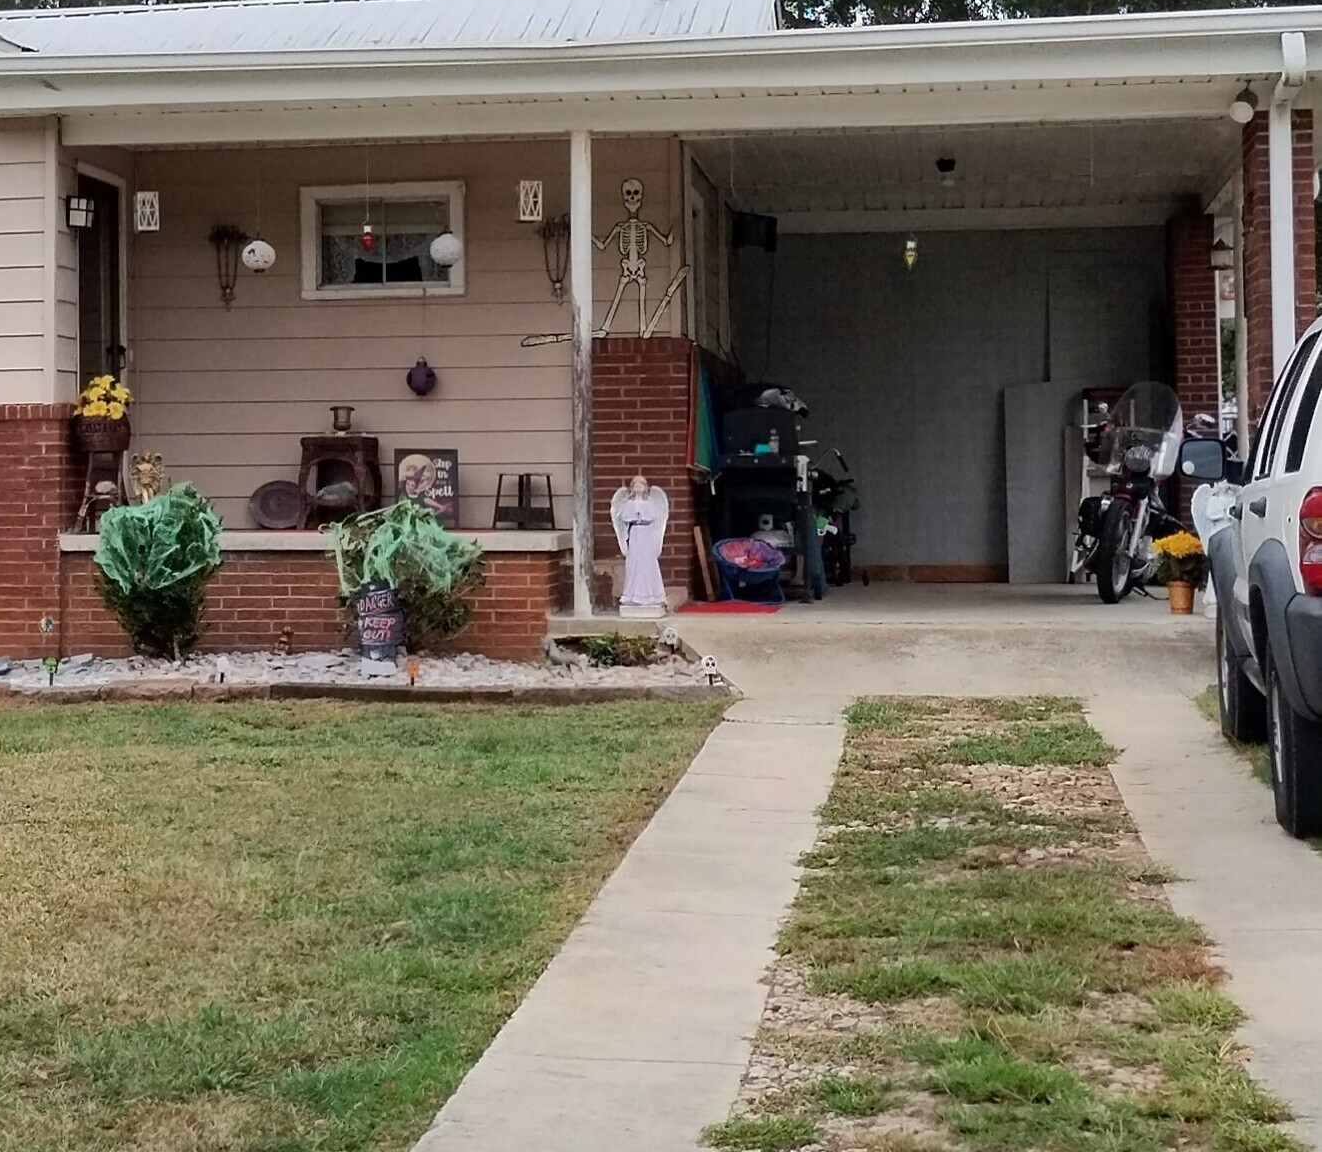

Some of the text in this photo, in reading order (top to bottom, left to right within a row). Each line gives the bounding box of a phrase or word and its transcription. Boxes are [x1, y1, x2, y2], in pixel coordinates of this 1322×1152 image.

[424, 486, 454, 499] Spell
[359, 592, 394, 612] DANGER
[364, 617, 396, 628] KEEP
